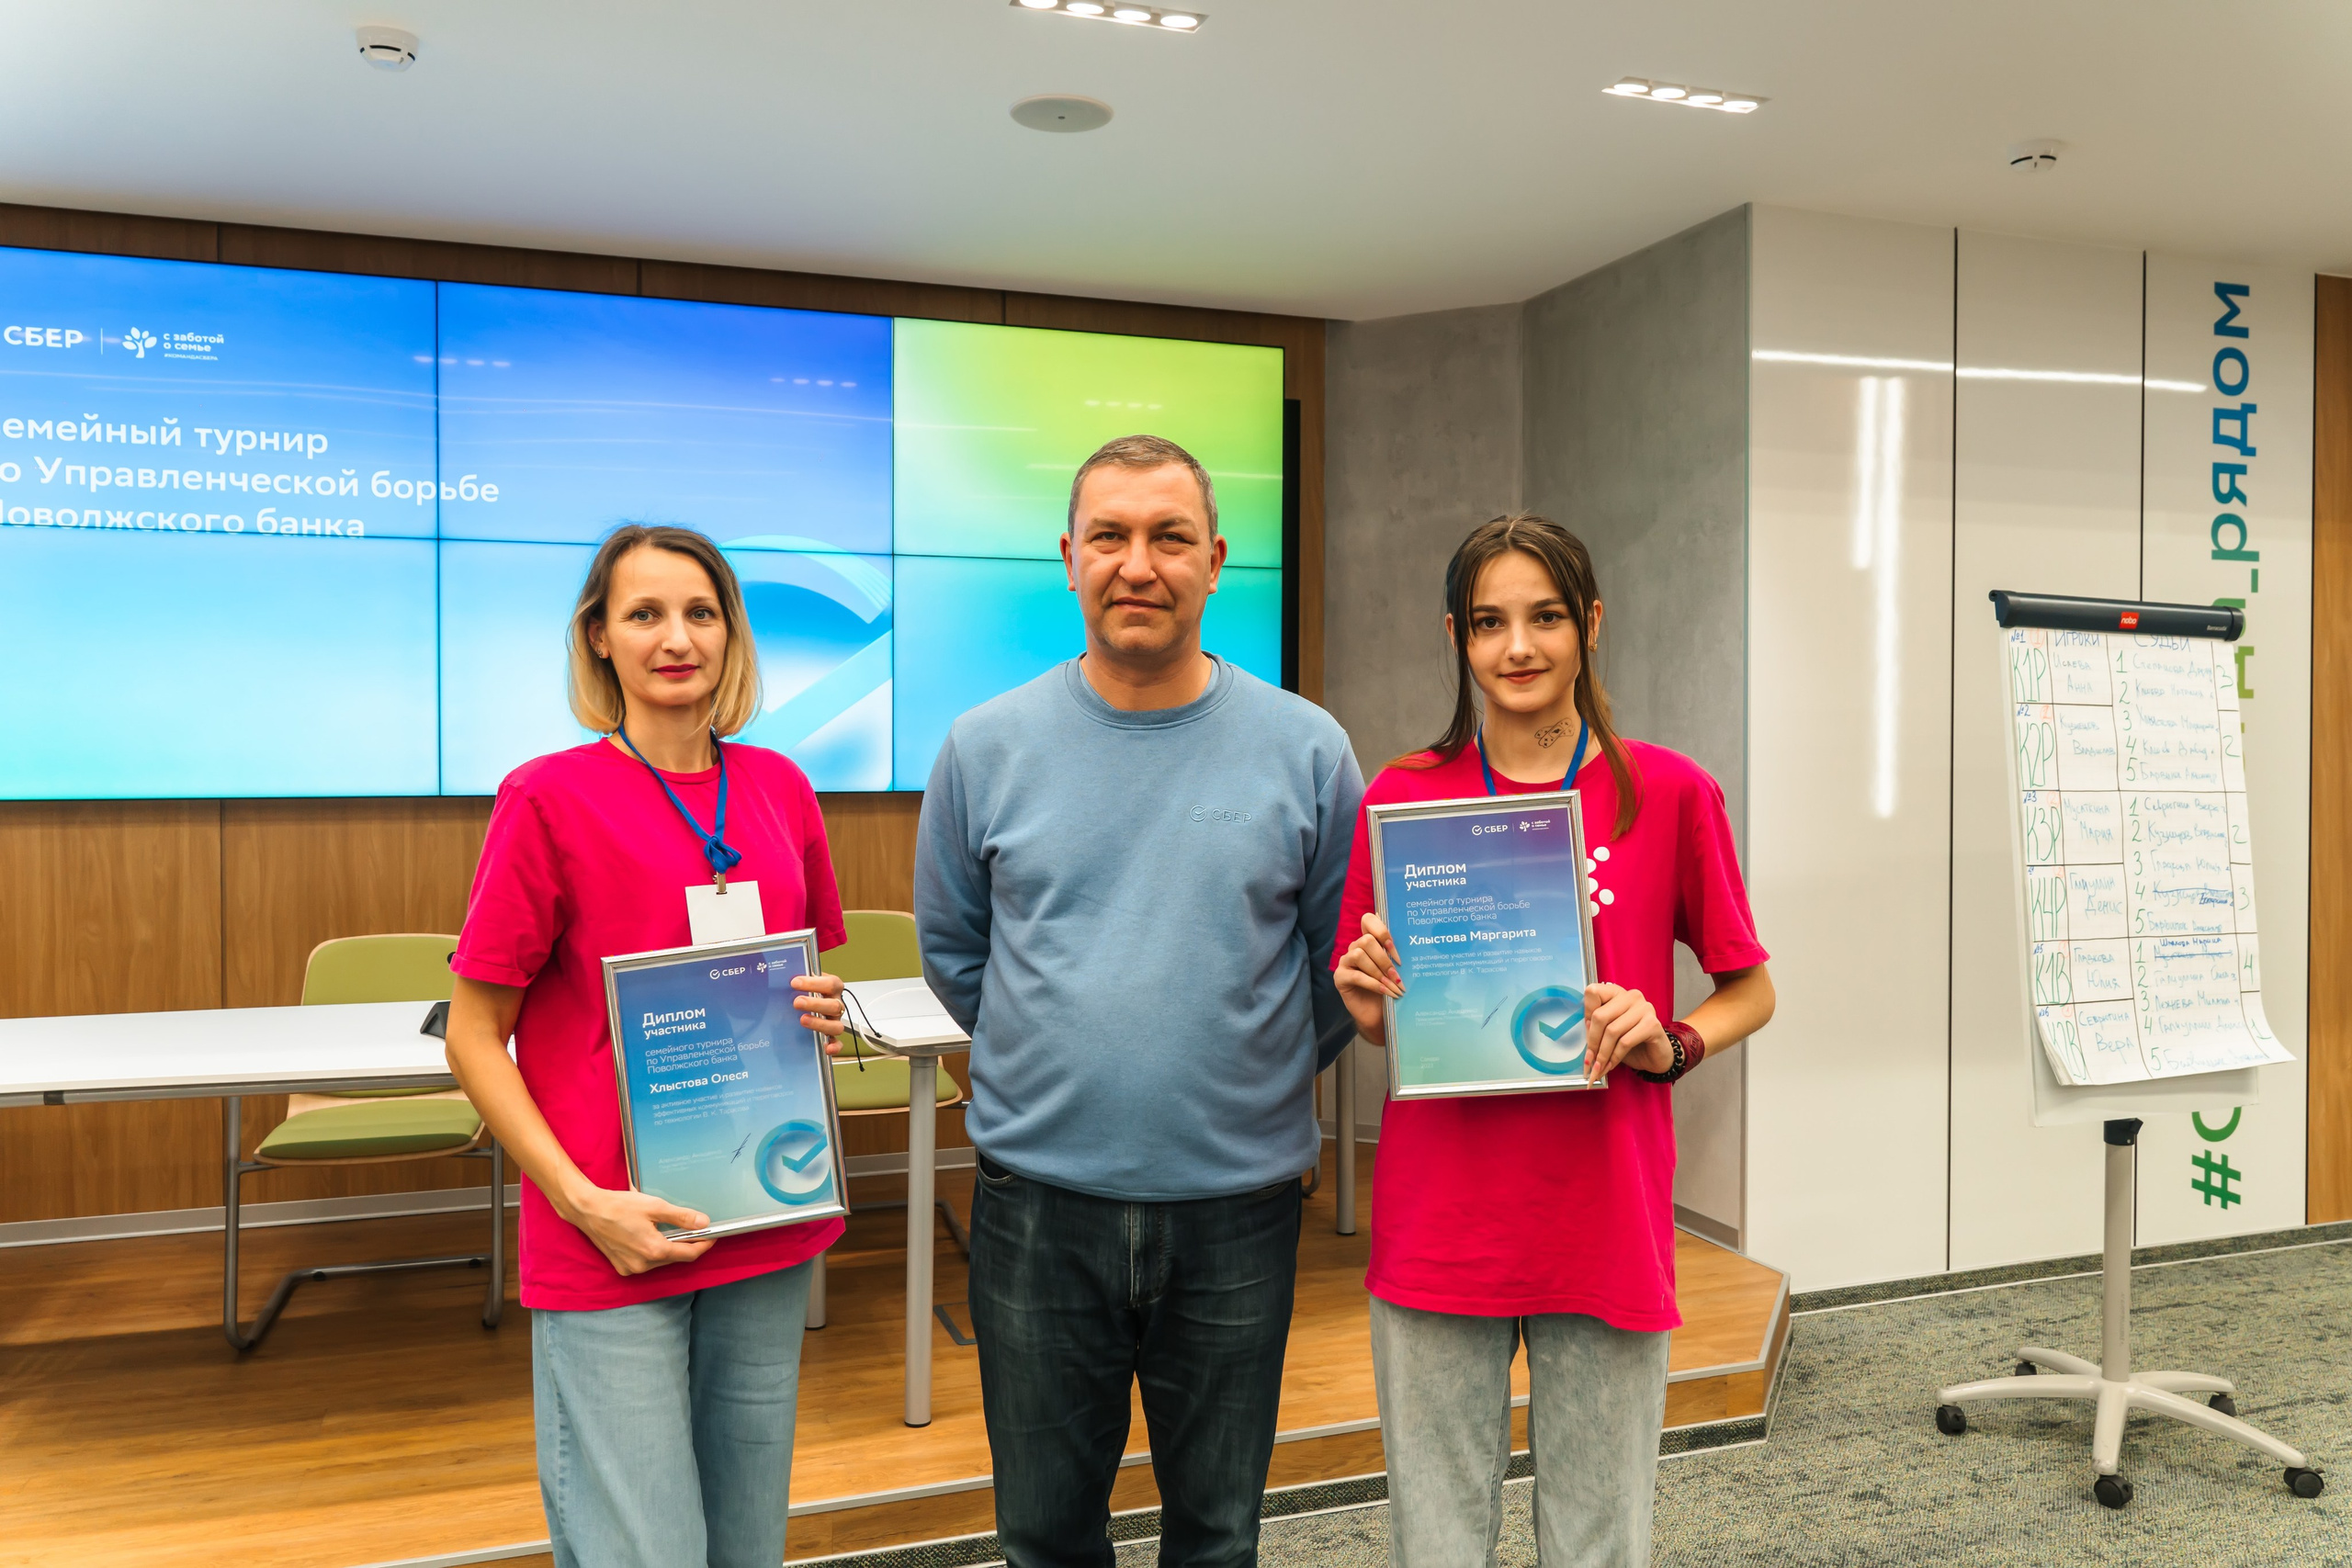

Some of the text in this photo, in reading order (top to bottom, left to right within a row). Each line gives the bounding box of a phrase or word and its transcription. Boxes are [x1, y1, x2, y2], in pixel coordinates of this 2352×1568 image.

[4, 325, 83, 348] СБЕР
[174, 332, 224, 344] заботой
[164, 342, 211, 352] о семье
[2, 412, 328, 459] емейный турнир
[0, 456, 499, 505] о Управленческой борьбе
[0, 499, 365, 537] оволжского банка
[2120, 616, 2137, 625] nobo
[2216, 665, 2233, 689] 3
[2222, 735, 2240, 757] 2
[1212, 808, 1251, 823] СБЕР
[1484, 824, 1508, 833] СБЕР
[2232, 825, 2247, 844] 2
[1404, 863, 1466, 879] Диплом
[1406, 877, 1467, 891] участника
[1406, 895, 1493, 908] семейного турнира
[2238, 886, 2250, 910] 3
[1407, 899, 1531, 917] по Управленческой борьбе
[1408, 912, 1497, 925] Поволжского банка
[1408, 929, 1536, 945] Хлыстова Маргарита
[1412, 962, 1454, 970] эффективных
[1455, 957, 1503, 967] коммуникаций
[1510, 954, 1553, 964] переговоров
[1451, 952, 1476, 961] участие
[1483, 949, 1512, 957] развитие
[722, 966, 746, 976] СБЕР
[1422, 969, 1459, 977] технологии
[1476, 965, 1507, 974] Тарасова
[642, 1008, 706, 1028] Диплом
[644, 1021, 707, 1040] участника
[645, 1037, 733, 1057] семейного турнира
[647, 1039, 770, 1066] по Управленческой борьбе
[648, 1054, 738, 1074] Поволжского банка
[650, 1071, 749, 1094] Хлыстова Олеся
[662, 1100, 691, 1109] активное
[693, 1094, 718, 1104] участие
[653, 1107, 696, 1118] эффективных
[664, 1114, 701, 1124] технологии
